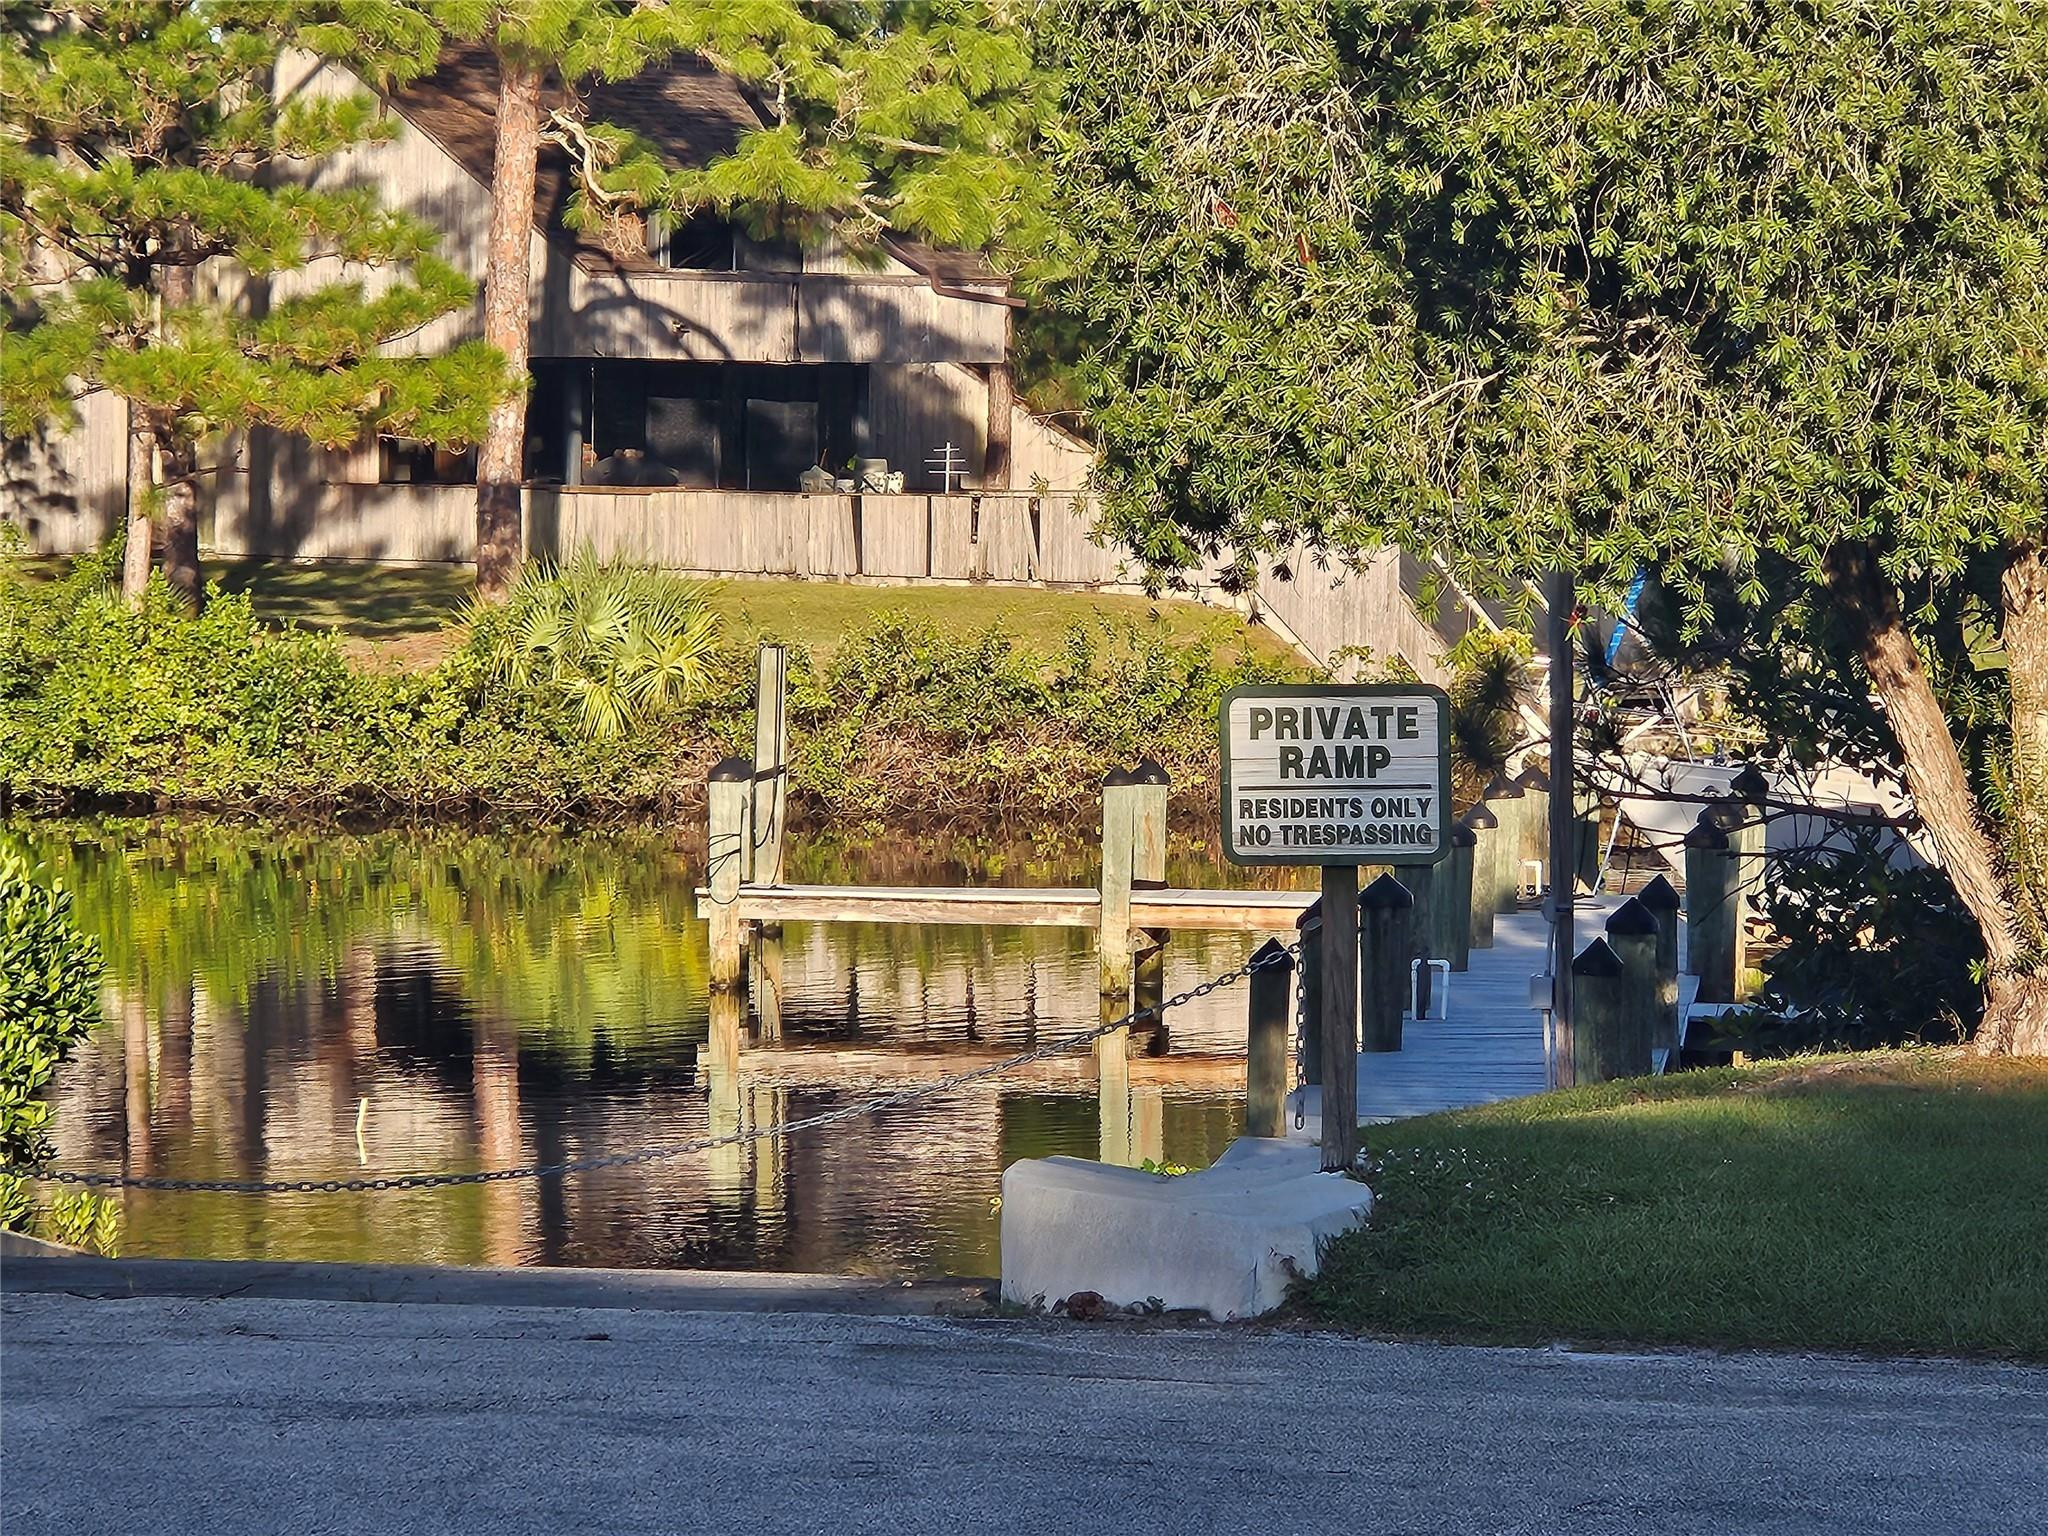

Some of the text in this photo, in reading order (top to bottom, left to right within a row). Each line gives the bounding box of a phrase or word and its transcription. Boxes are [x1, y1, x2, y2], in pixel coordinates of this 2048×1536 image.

[1250, 707, 1419, 740] PRIVATE
[1279, 745, 1391, 779] RAMP
[1239, 798, 1432, 819] RESIDENTS ONLY
[1240, 824, 1432, 845] NO TRESPASSING
